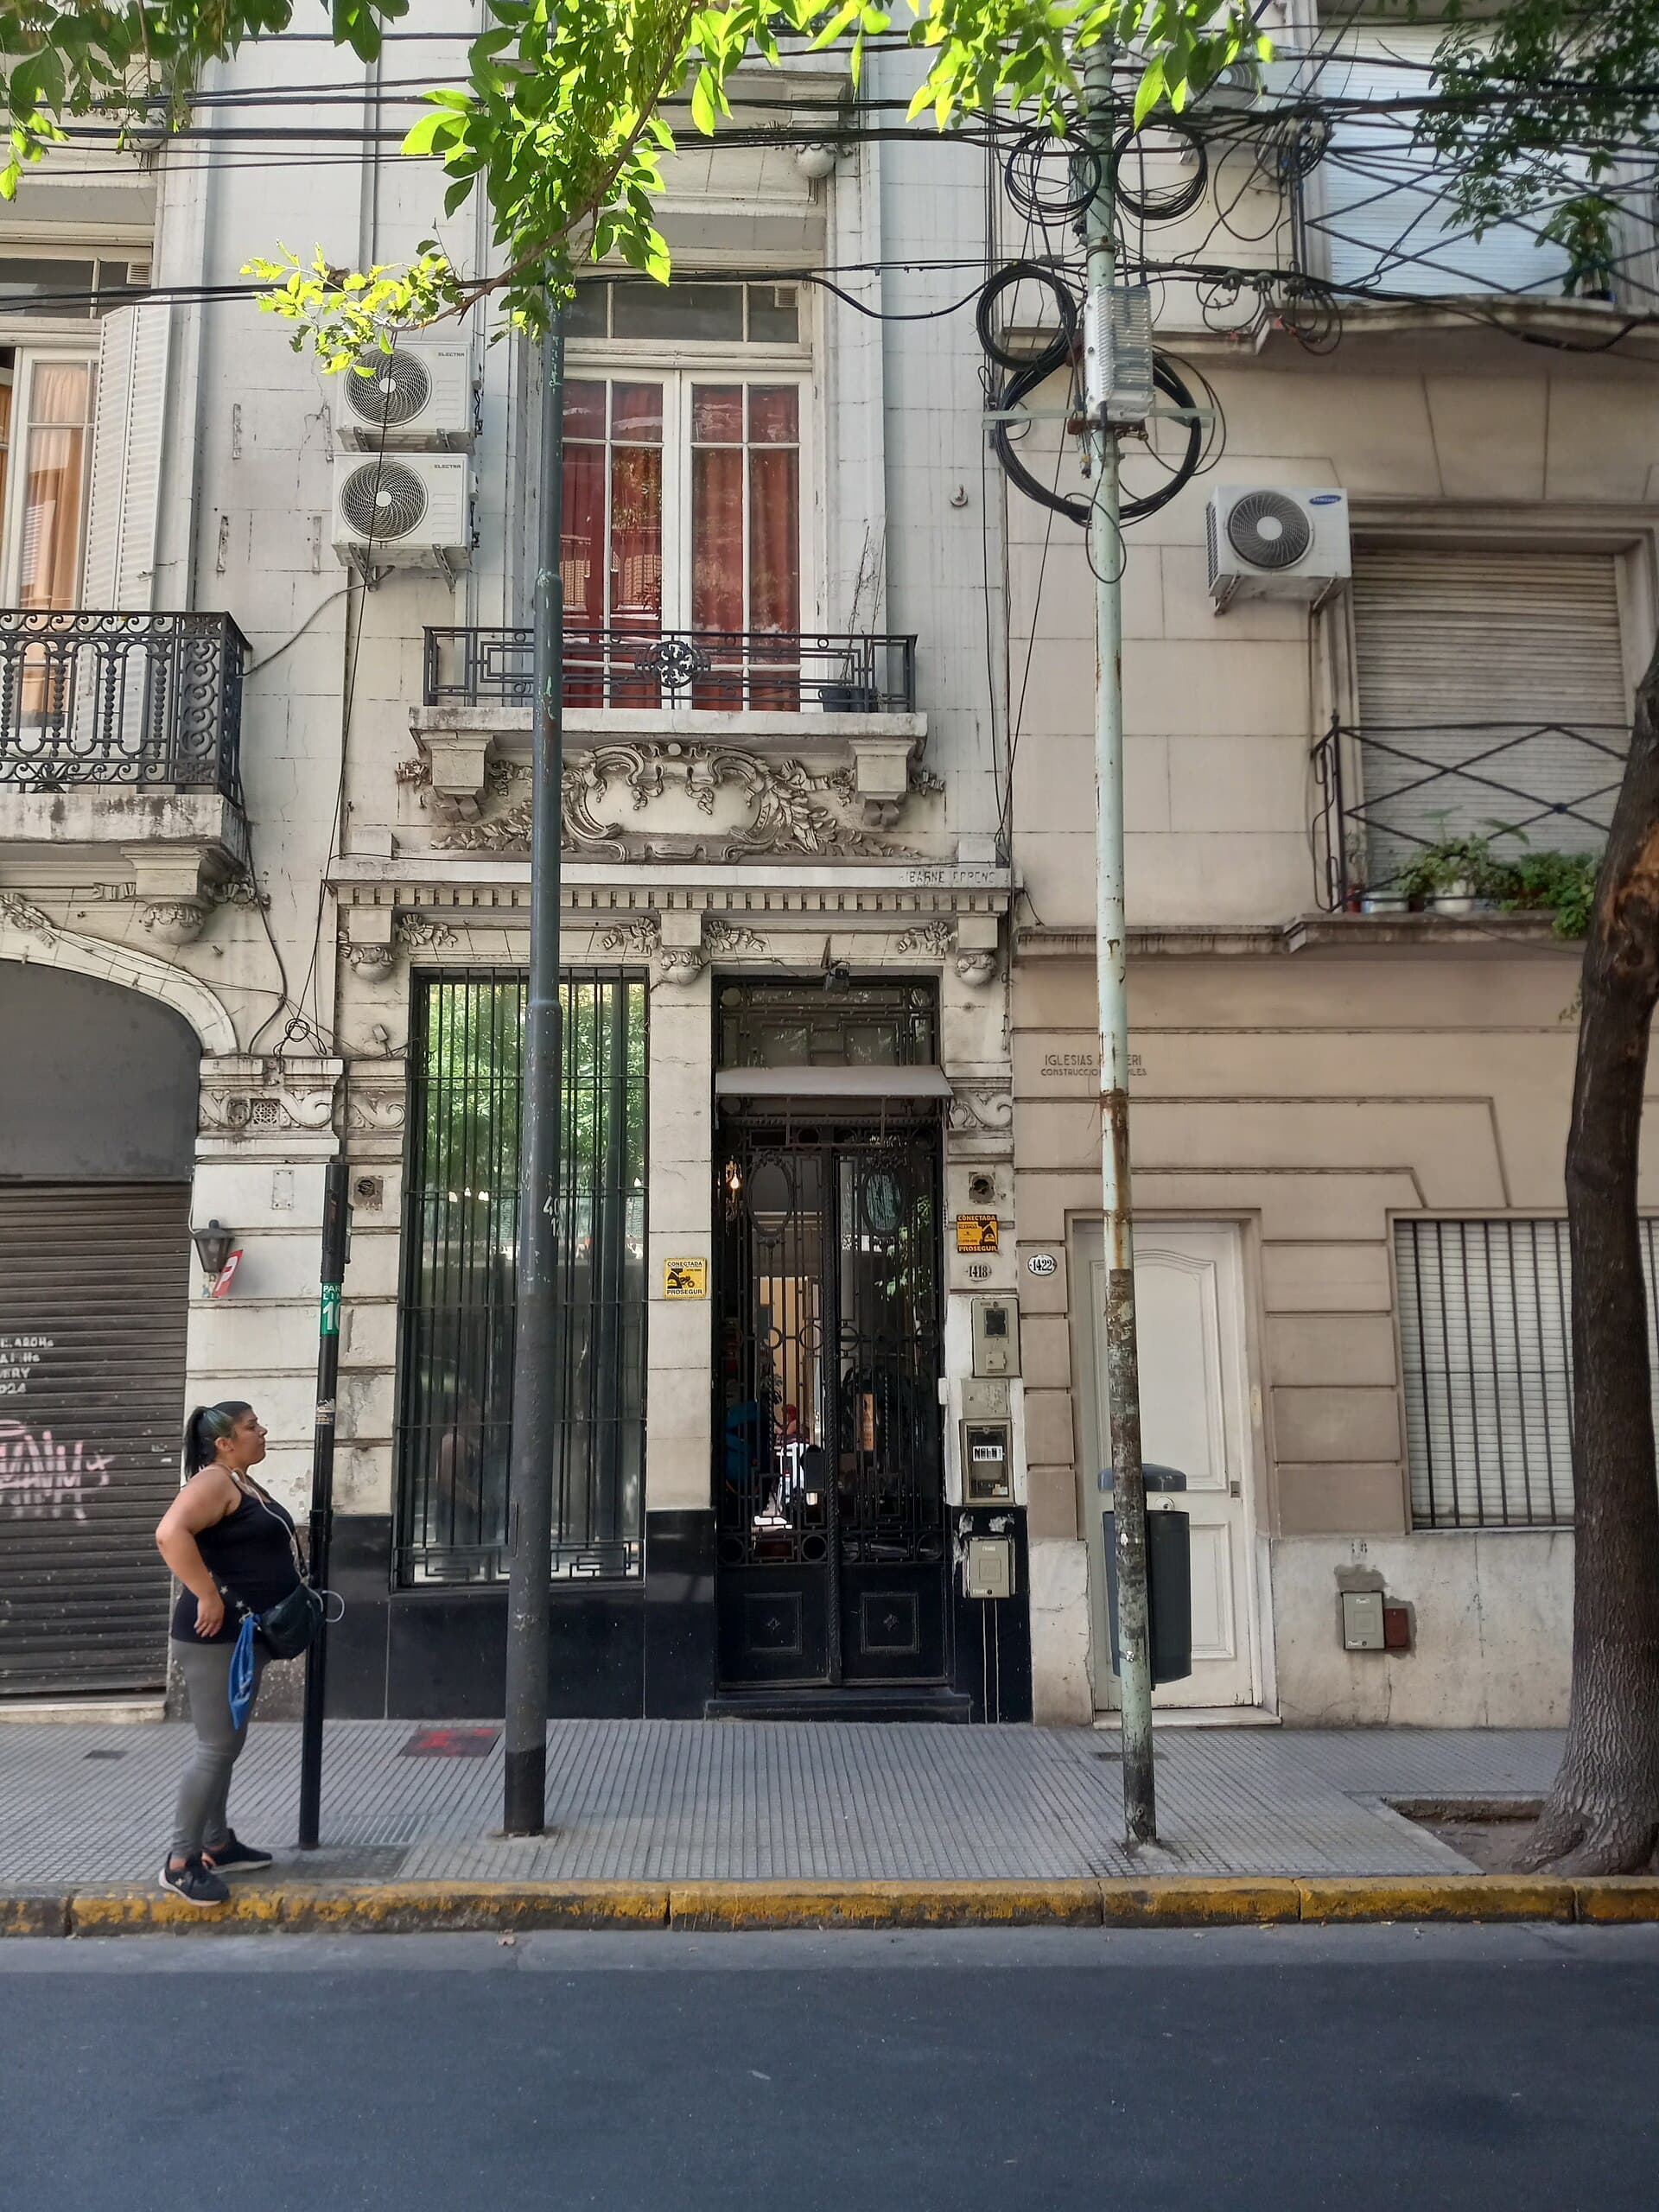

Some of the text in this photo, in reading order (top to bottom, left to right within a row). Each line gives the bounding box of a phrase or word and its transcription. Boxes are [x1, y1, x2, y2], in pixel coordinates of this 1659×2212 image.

[1045, 1054, 1093, 1066] IGLESIAS
[1033, 1259, 1052, 1271] 1422
[969, 1265, 988, 1278] 1418
